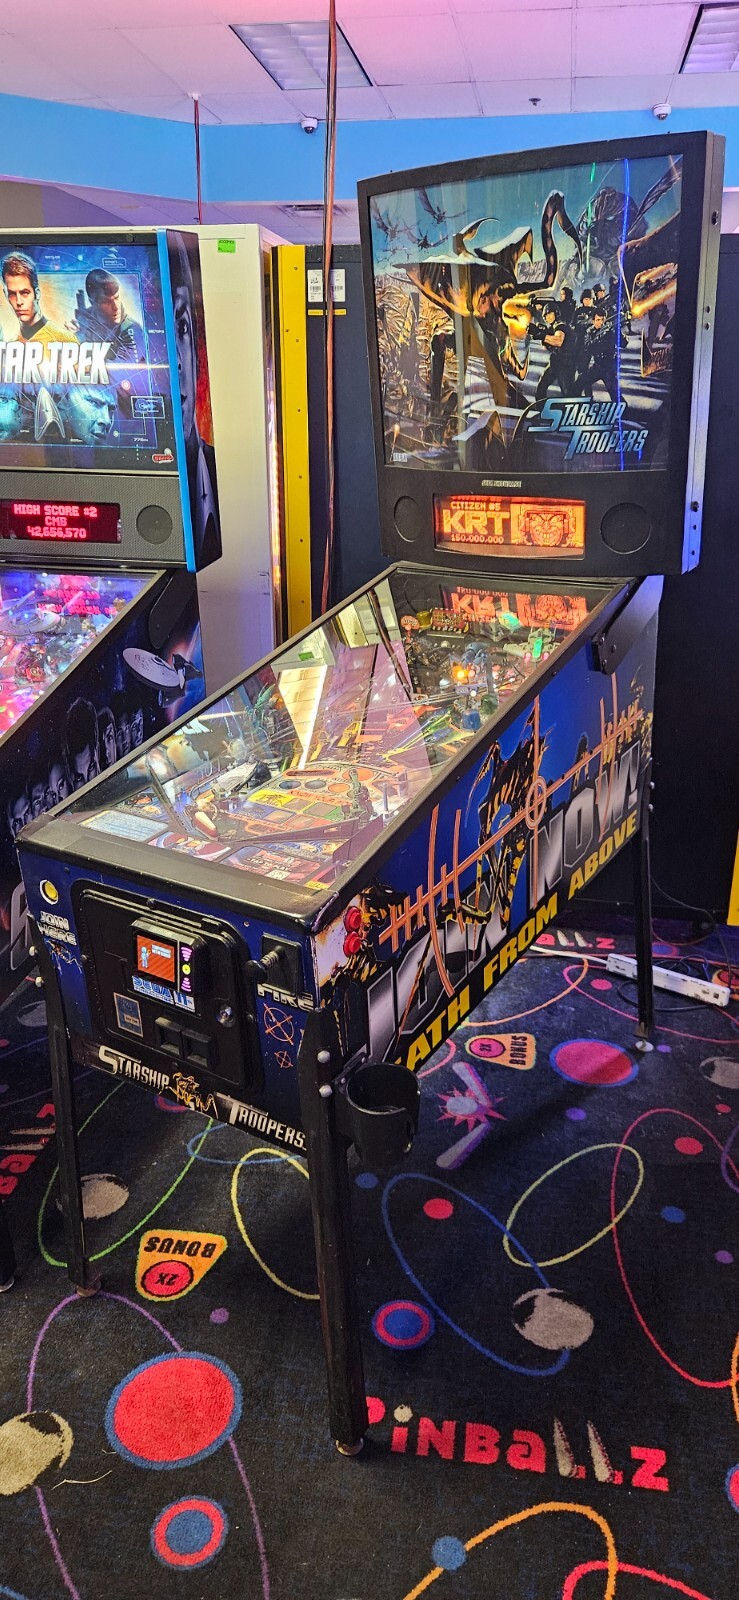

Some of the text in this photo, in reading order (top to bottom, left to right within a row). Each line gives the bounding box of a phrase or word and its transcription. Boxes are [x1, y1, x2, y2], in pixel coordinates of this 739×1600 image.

[47, 341, 111, 385] TREK
[528, 397, 627, 432] STARSHIP
[559, 425, 648, 460] TROOPERS
[13, 503, 98, 518] HIGH SCORE #2
[450, 501, 486, 510] CITIZEN
[44, 516, 68, 527] CMB
[443, 509, 510, 536] KRT
[530, 740, 641, 908] NOW!
[36, 920, 77, 946] HERE
[40, 910, 70, 931] JOIN
[394, 809, 638, 1073] ATH FROM ABOVE
[509, 1035, 528, 1066] BONUS
[98, 1045, 306, 1149] STARSHIP TROOPERS
[144, 1236, 217, 1258] BONUS
[155, 1272, 180, 1286] 2X
